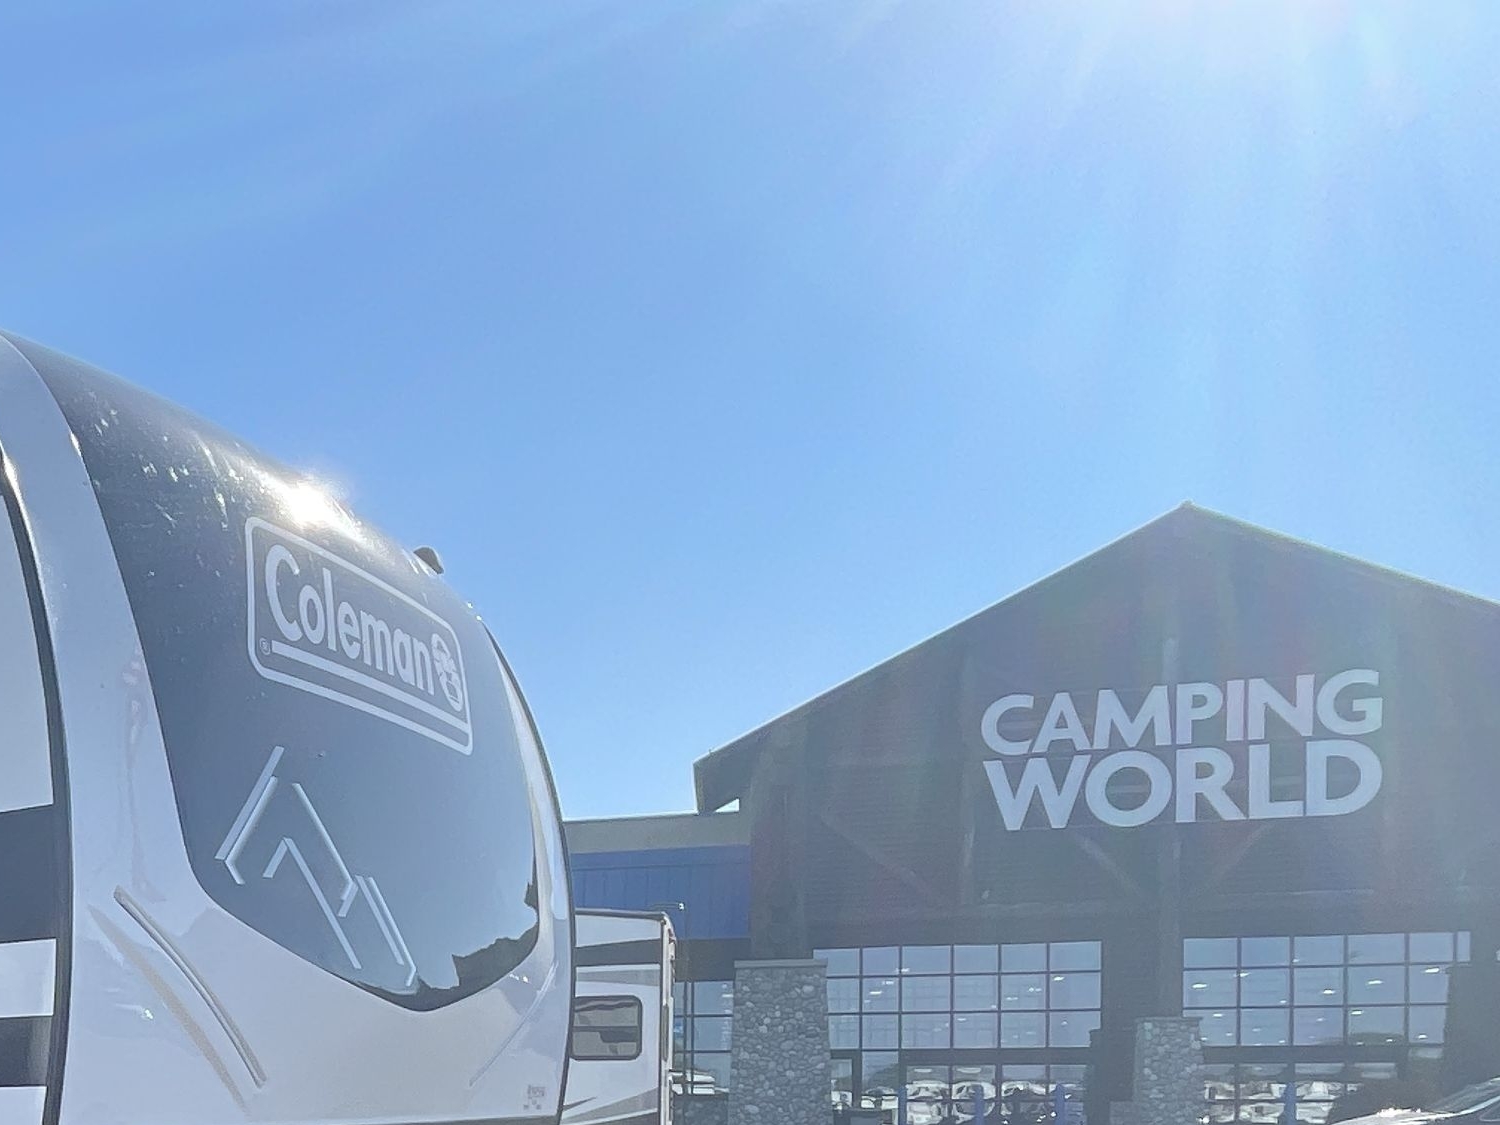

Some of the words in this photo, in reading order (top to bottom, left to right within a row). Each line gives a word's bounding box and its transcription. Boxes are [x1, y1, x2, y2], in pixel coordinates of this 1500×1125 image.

[265, 544, 435, 696] Coleman
[981, 668, 1383, 755] CAMPING
[982, 739, 1383, 831] WORLD
